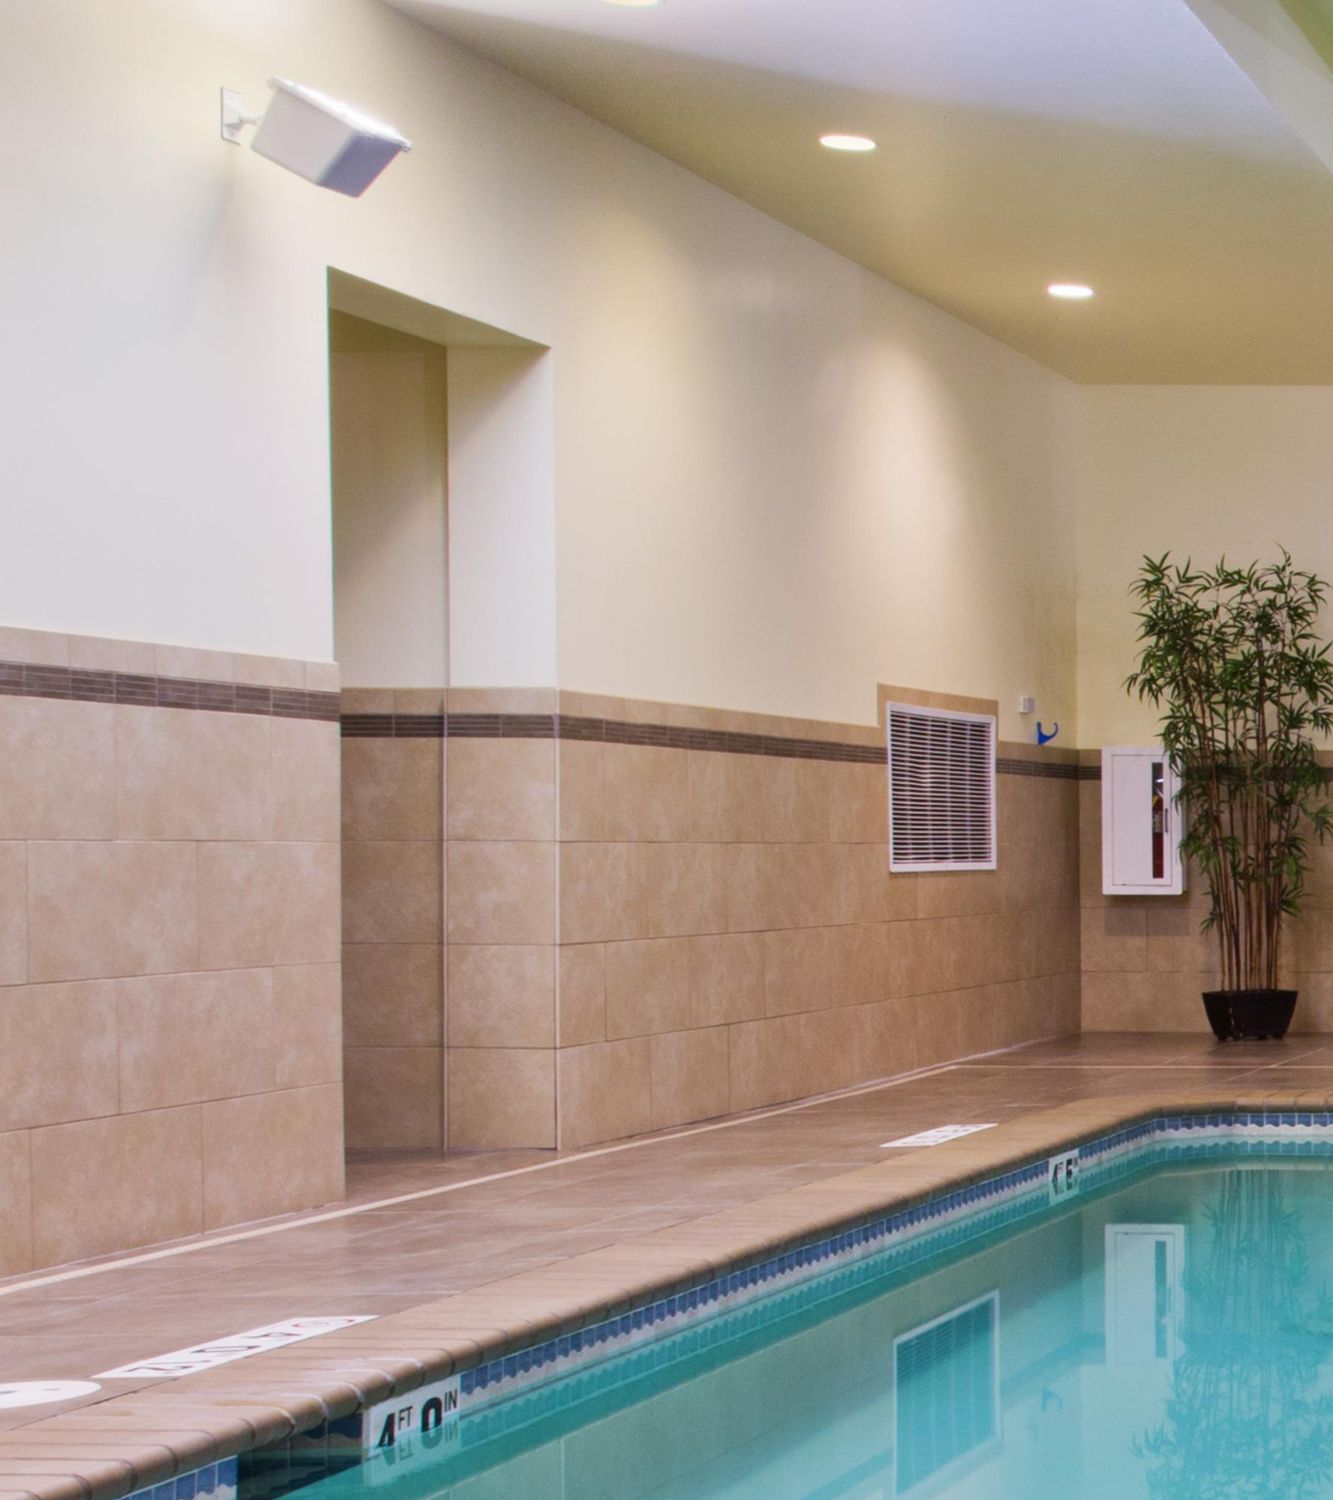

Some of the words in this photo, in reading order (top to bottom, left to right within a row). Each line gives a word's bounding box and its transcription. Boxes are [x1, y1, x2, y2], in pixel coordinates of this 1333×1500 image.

[375, 1412, 396, 1448] 4
[398, 1405, 413, 1430] FT
[444, 1388, 459, 1413] IN
